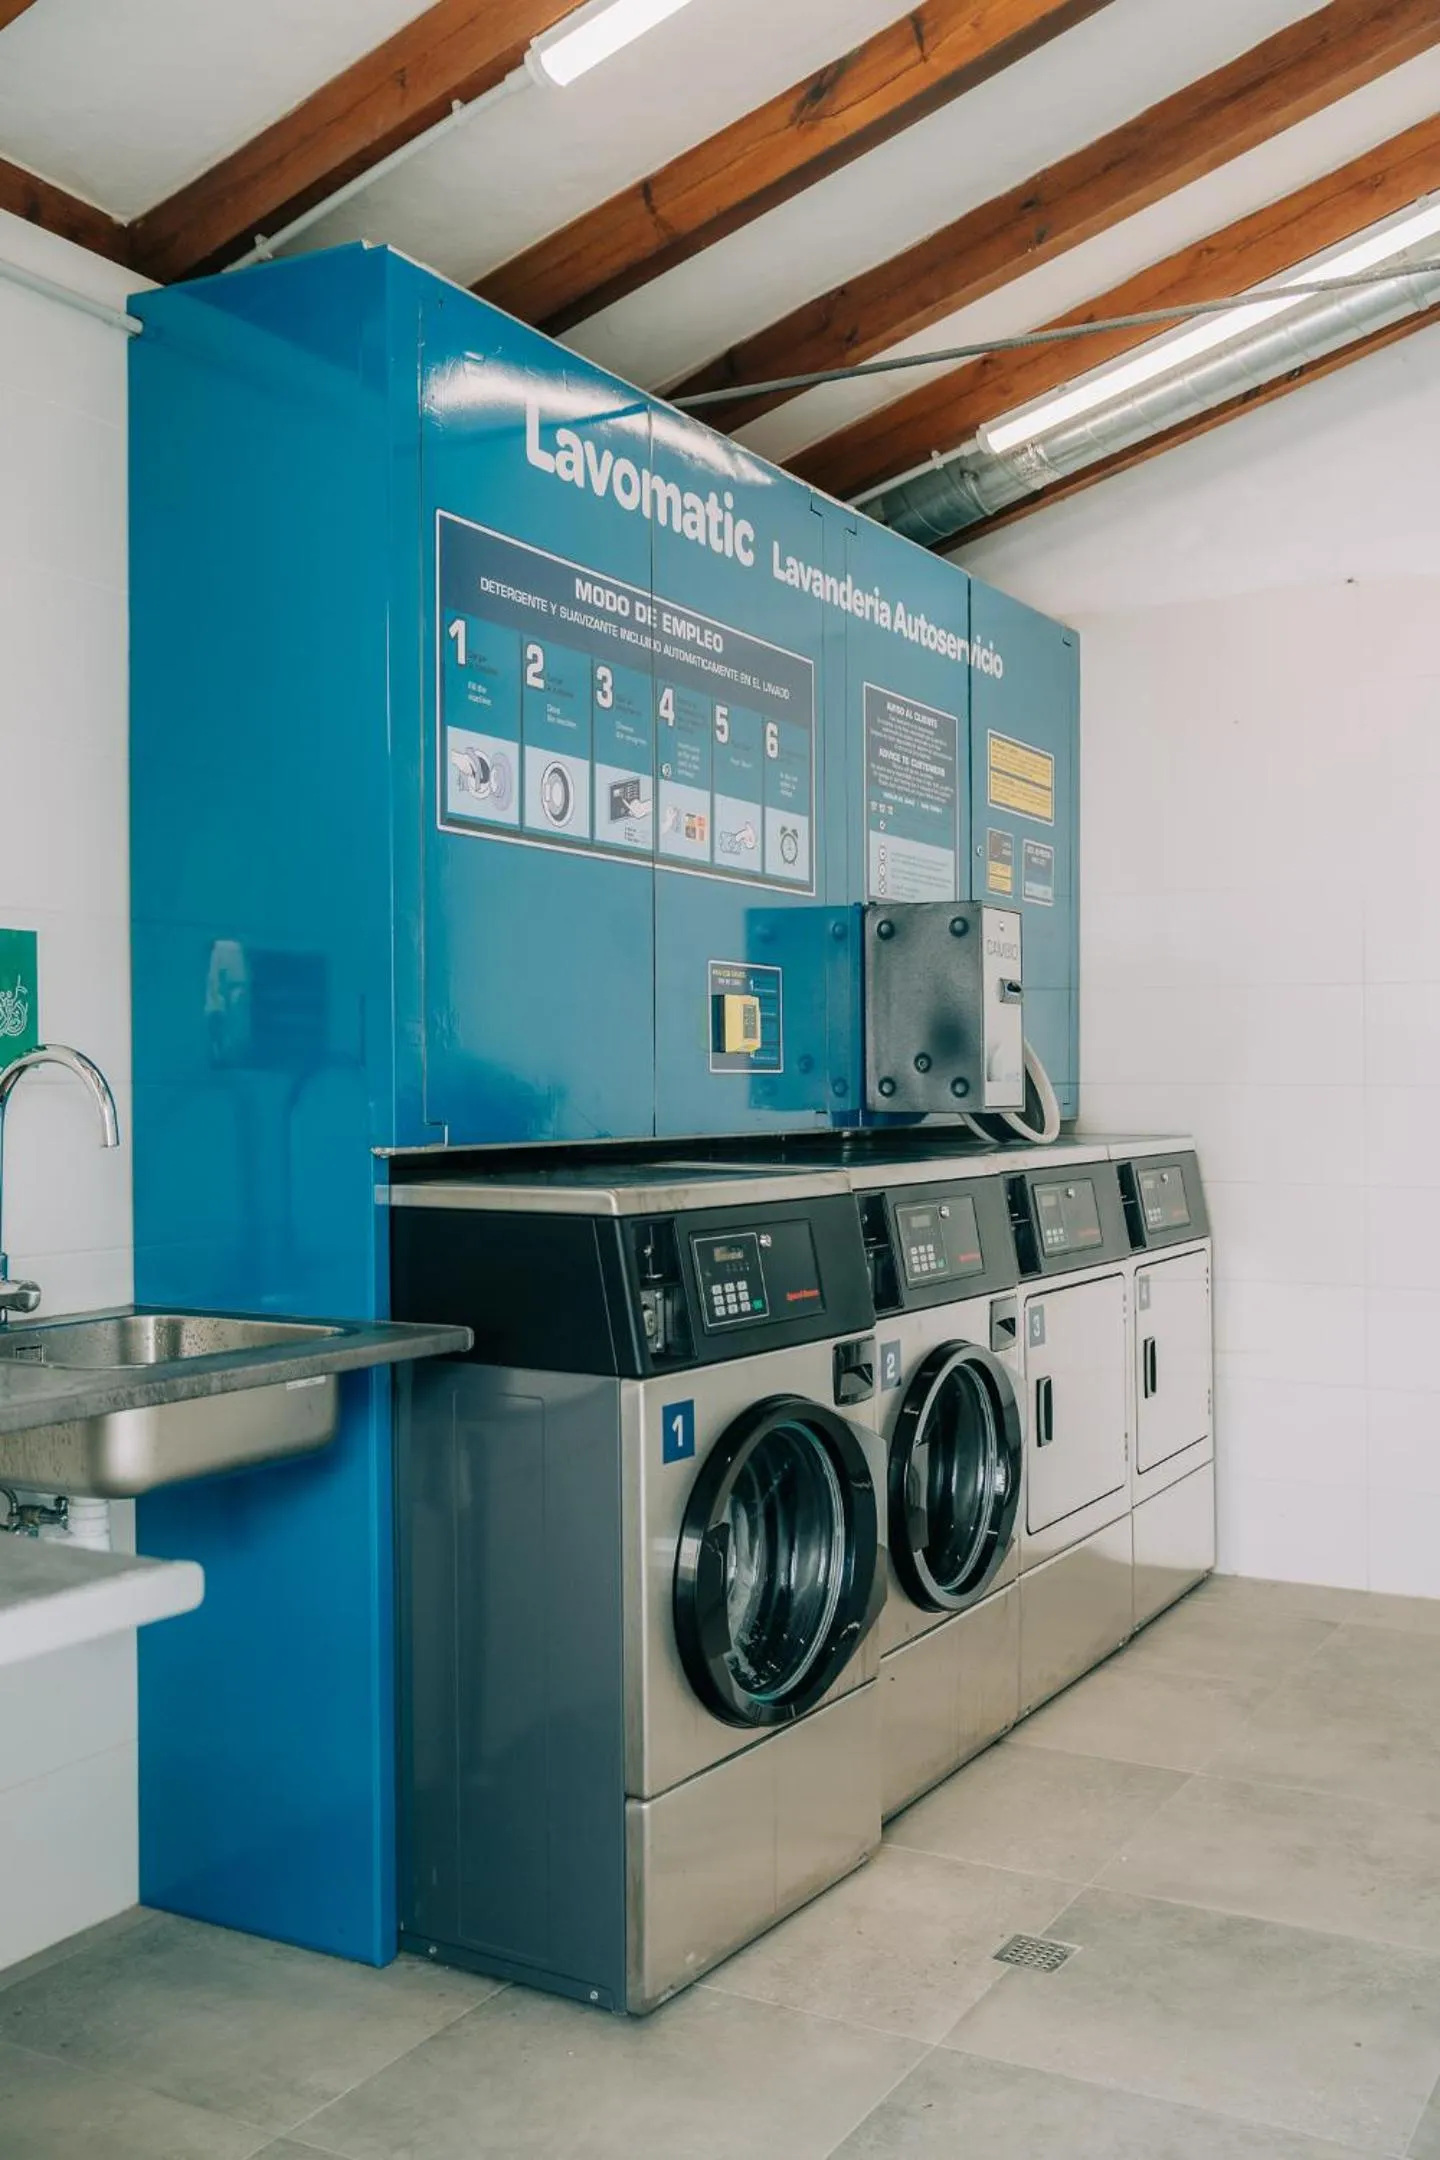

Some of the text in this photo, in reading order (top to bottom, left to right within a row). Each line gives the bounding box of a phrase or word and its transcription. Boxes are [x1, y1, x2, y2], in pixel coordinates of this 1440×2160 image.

[525, 399, 754, 567] Lavomatic
[575, 577, 724, 653] MODO DE EMPLEO
[773, 540, 1004, 679] Lavanderia Autoservicio
[448, 618, 466, 665] 1
[480, 577, 547, 613] DETERGENTE
[549, 601, 556, 616] Y
[560, 606, 618, 638] SUAVIZANTE
[620, 627, 662, 653] INCLUIDO
[740, 672, 751, 686] EN
[752, 675, 761, 690] EL
[762, 680, 790, 699] LAVADO
[526, 643, 545, 689] 2
[596, 666, 613, 708] 3
[659, 687, 675, 727] 4
[715, 704, 729, 744] 5
[766, 722, 778, 759] 6
[1033, 1314, 1041, 1337] 3
[886, 1352, 895, 1379] 2
[671, 1414, 684, 1447] 1
